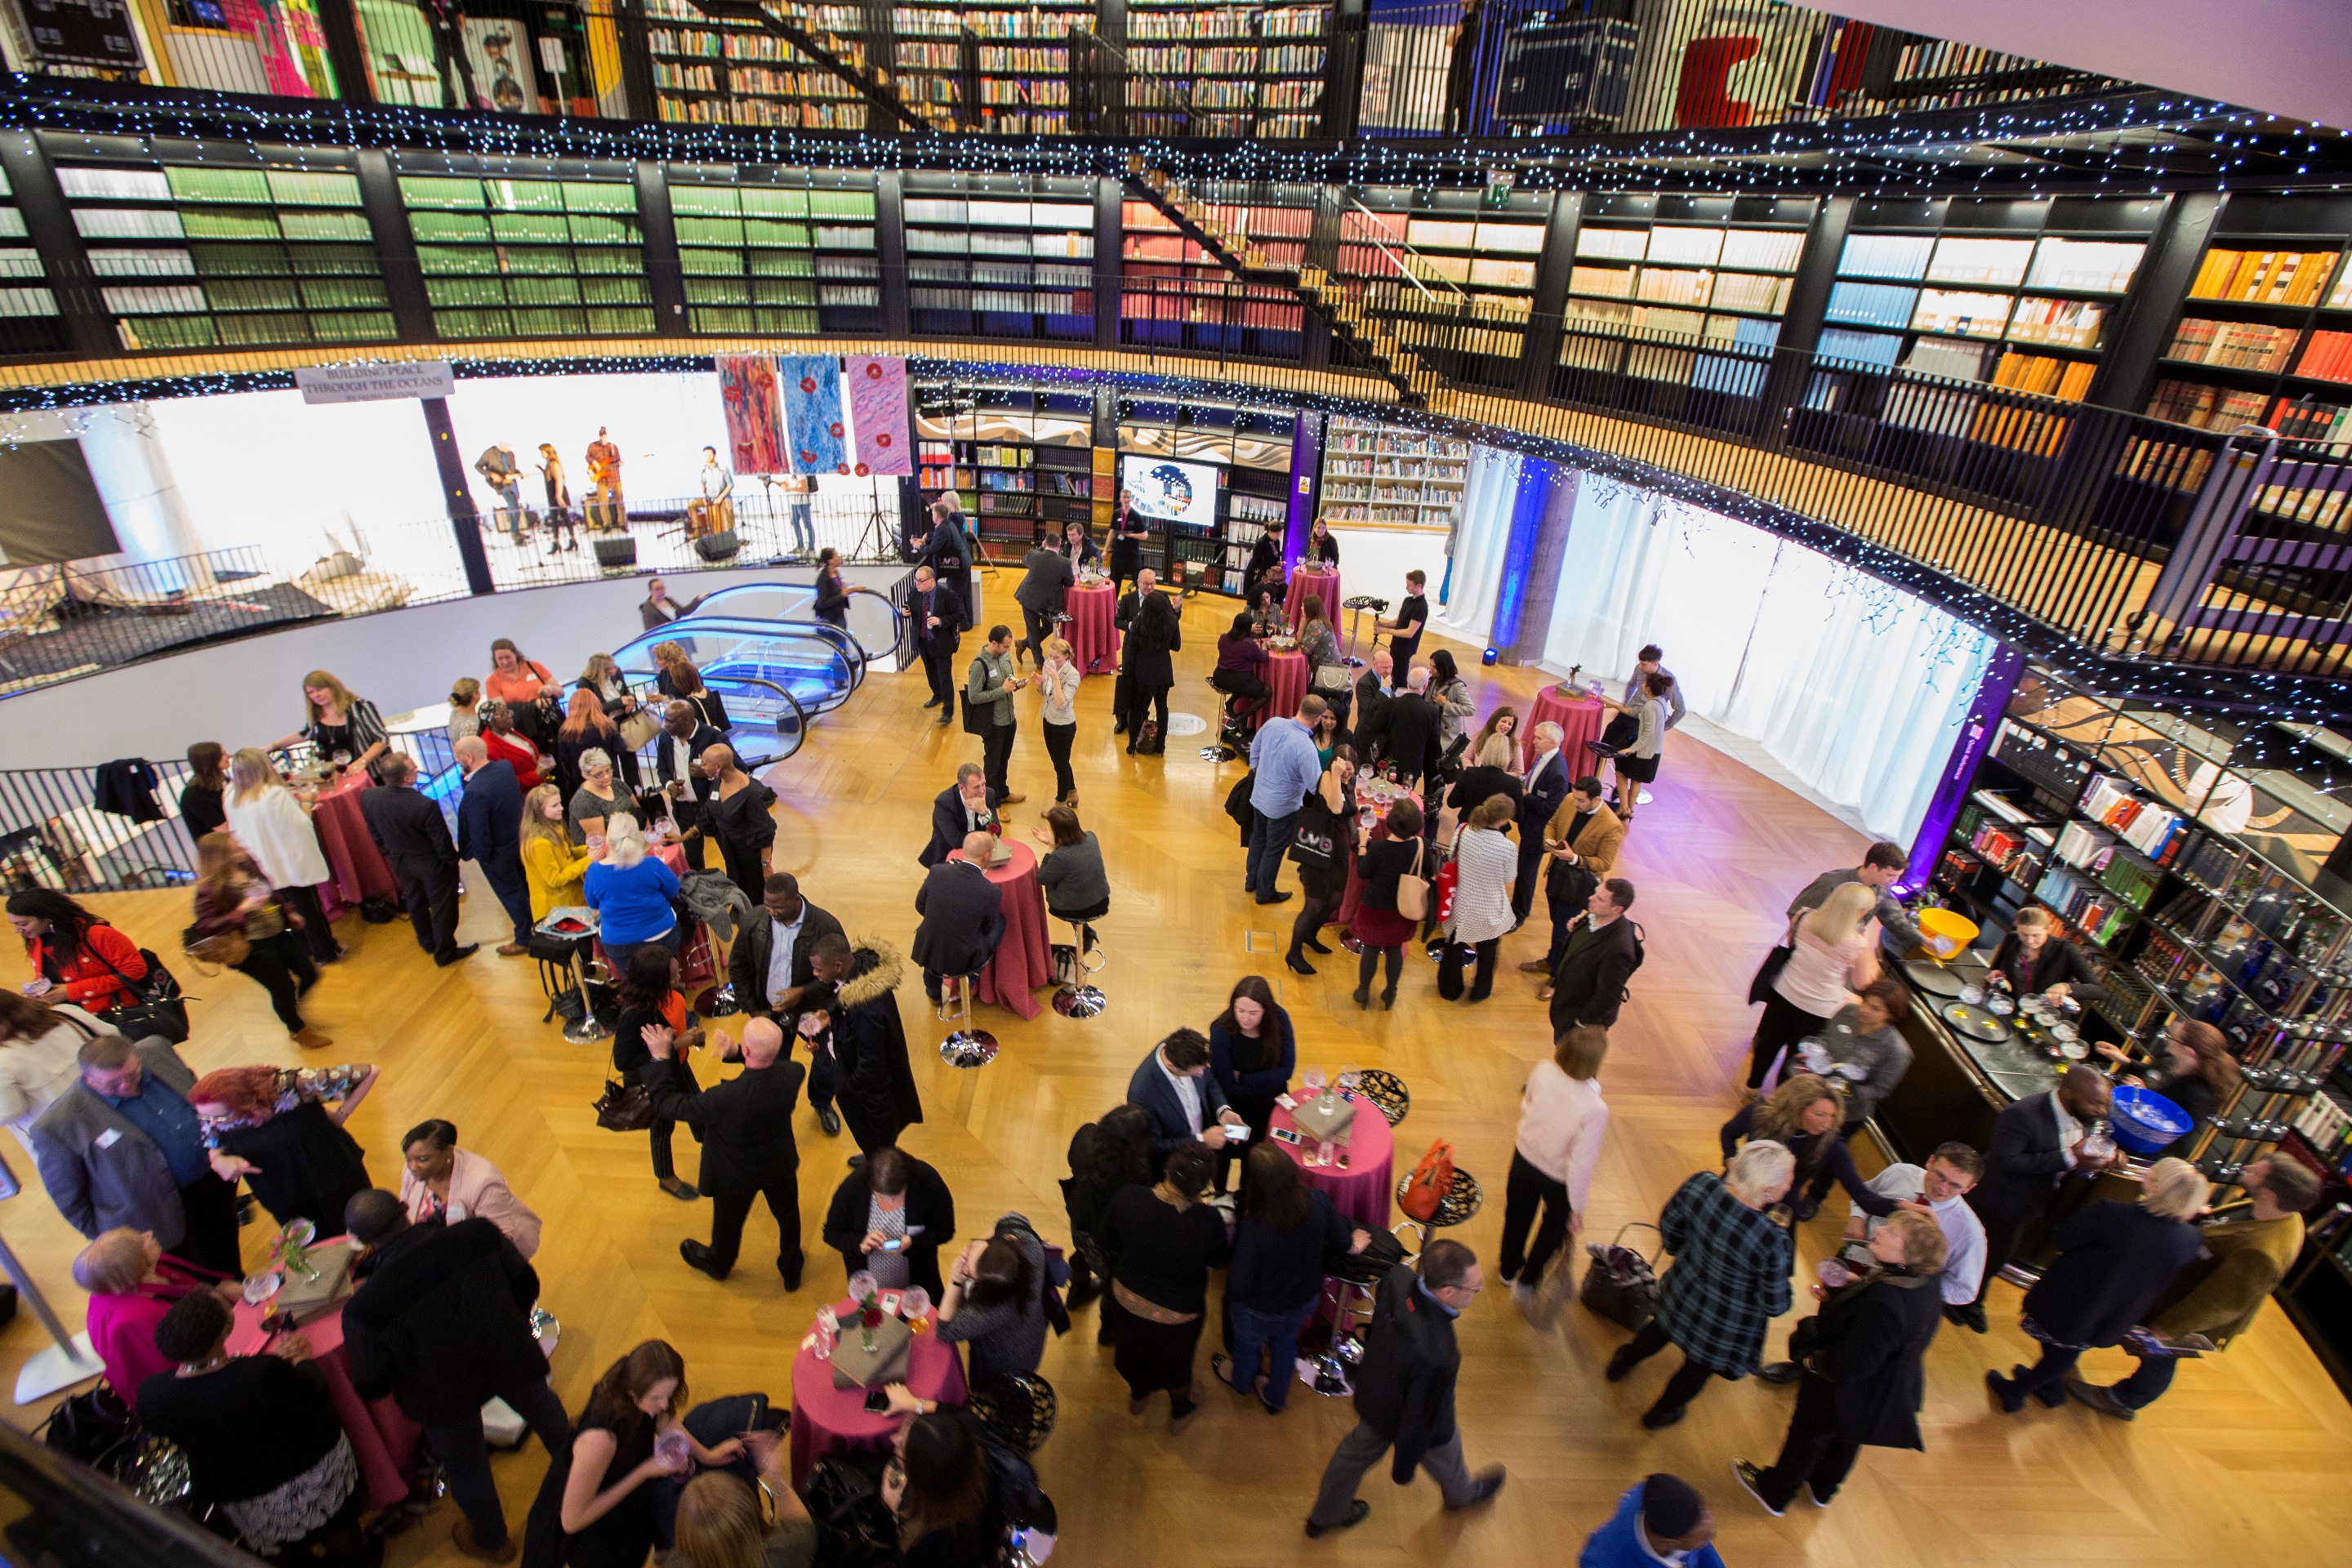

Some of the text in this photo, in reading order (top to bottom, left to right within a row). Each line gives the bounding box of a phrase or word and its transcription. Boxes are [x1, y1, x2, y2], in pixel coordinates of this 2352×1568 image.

[327, 364, 422, 380] BUILDING PEACE
[304, 376, 443, 394] THROUGH THE OCEANS
